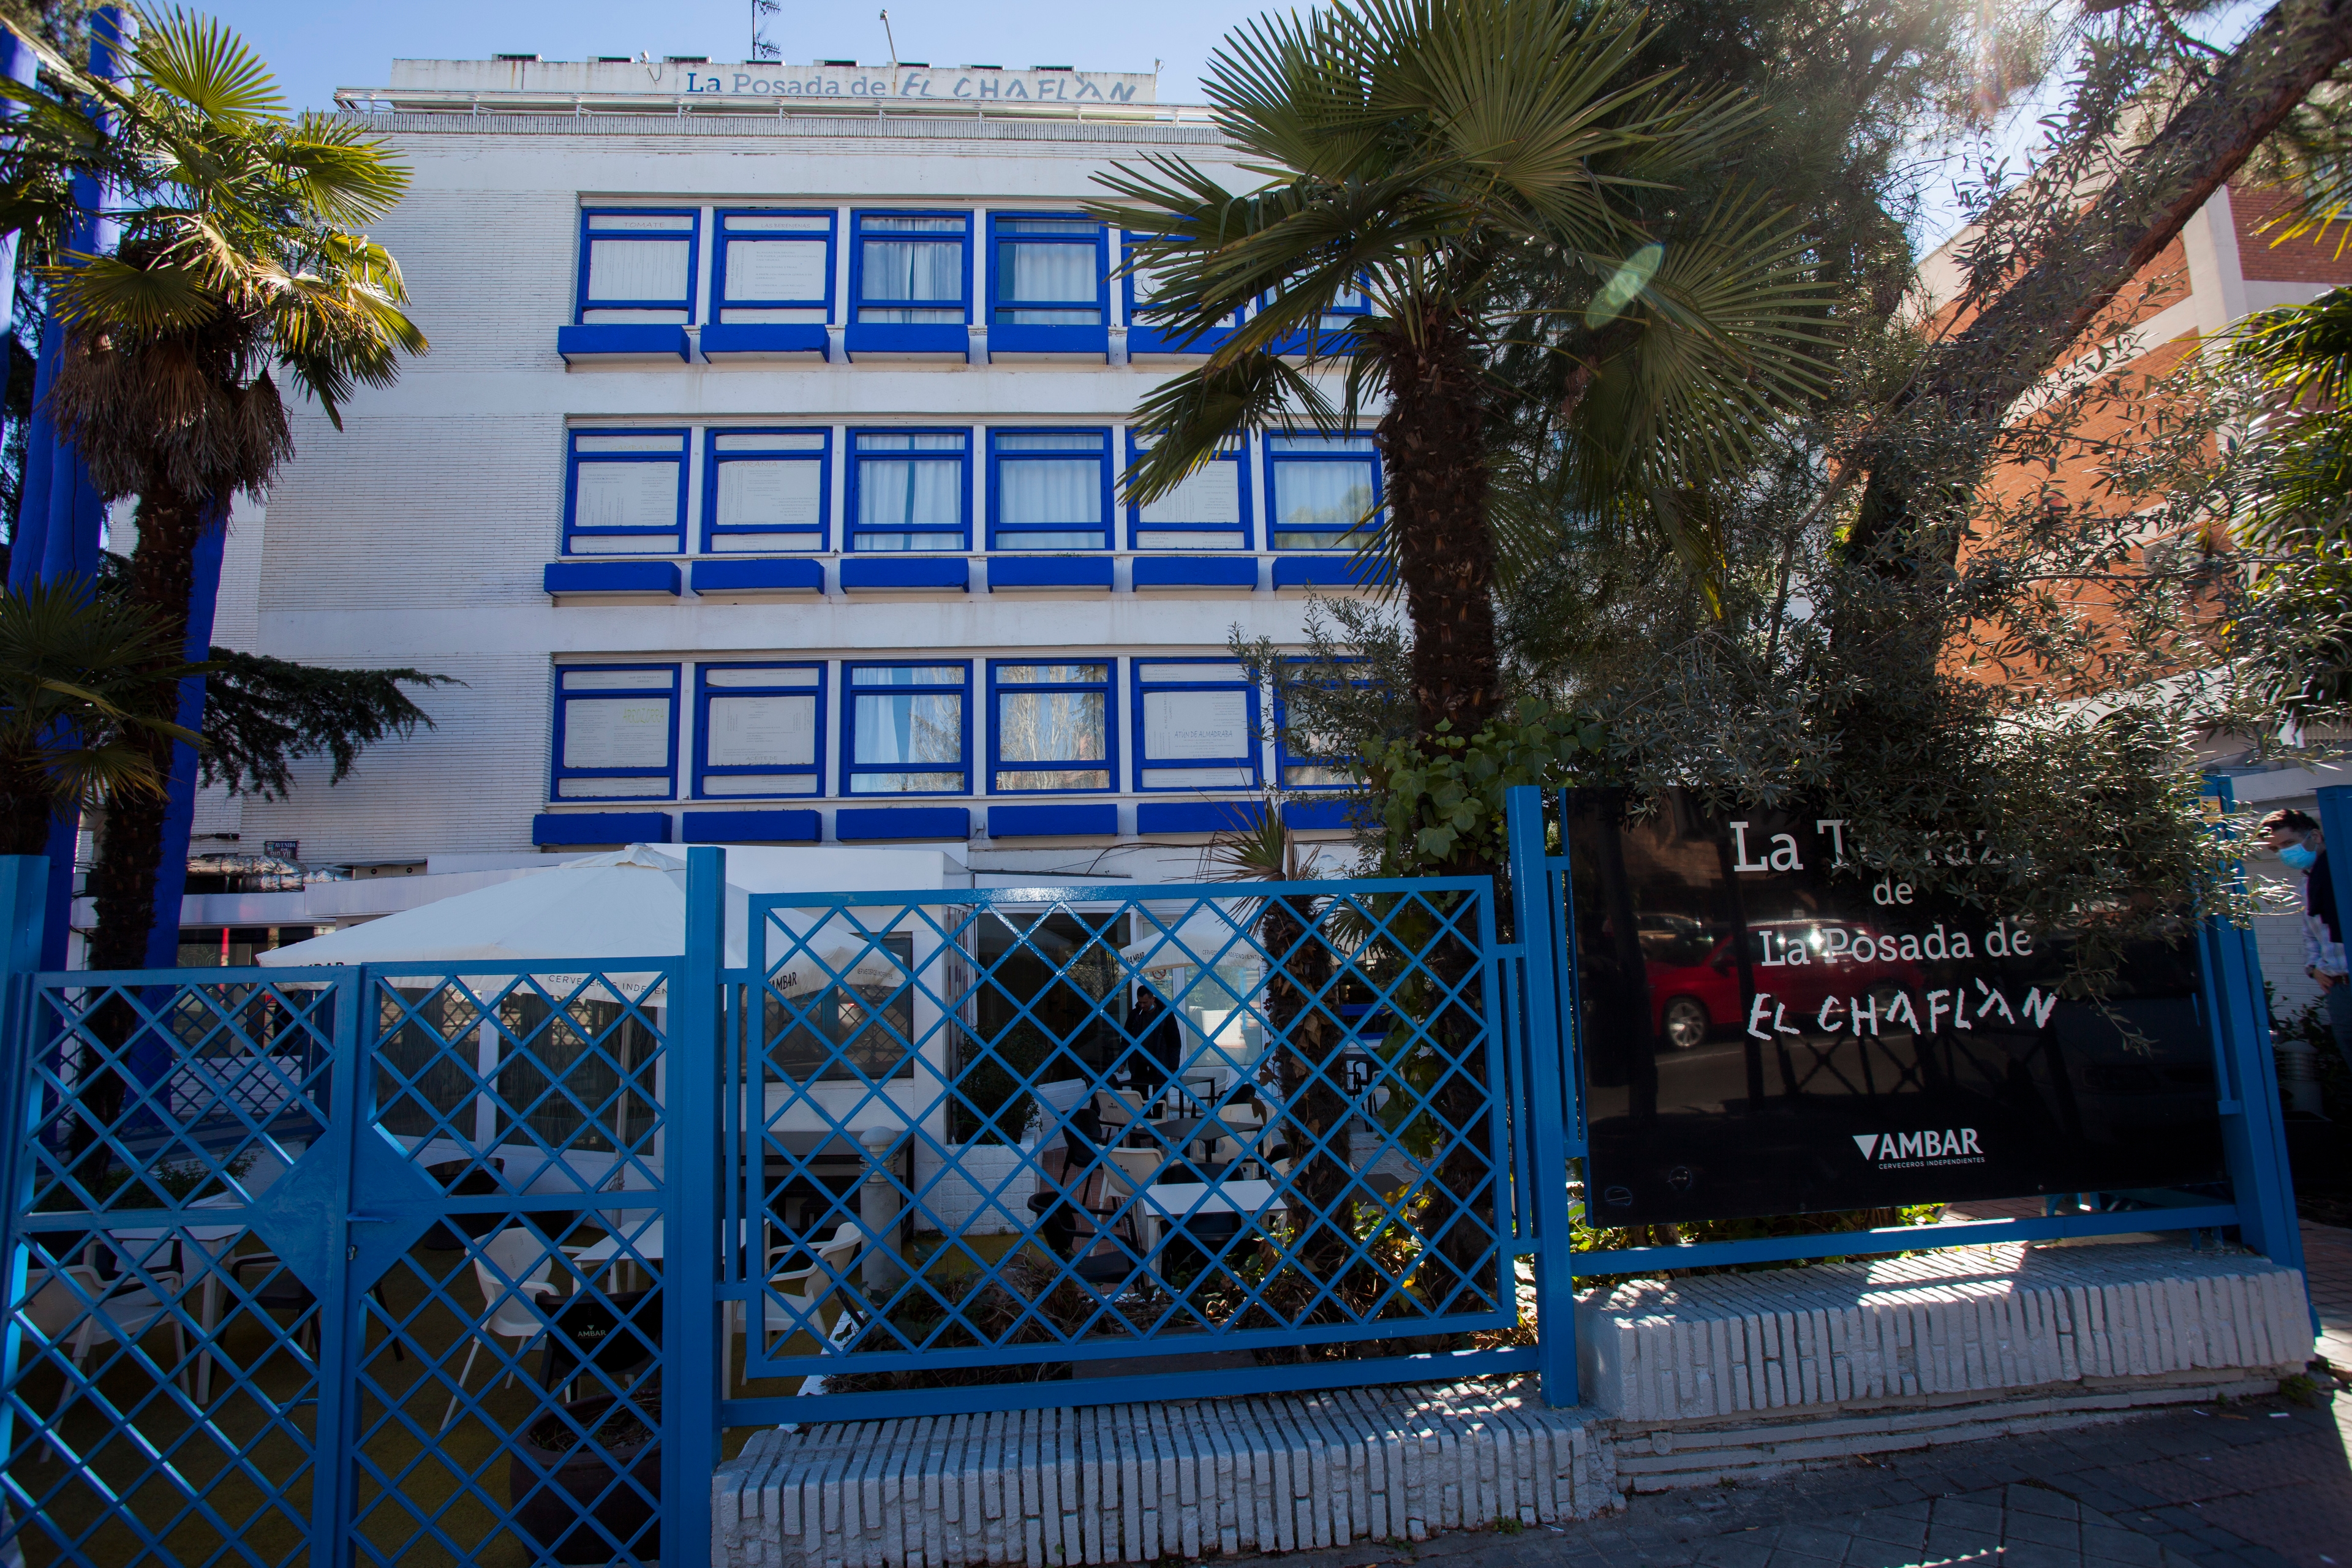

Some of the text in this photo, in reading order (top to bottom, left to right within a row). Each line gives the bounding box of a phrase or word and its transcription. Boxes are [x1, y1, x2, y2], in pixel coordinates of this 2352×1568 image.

[687, 73, 721, 93] La
[732, 73, 839, 94] Posada
[851, 76, 886, 96] de
[900, 73, 932, 97] EL
[623, 707, 664, 723] ARROZORRA
[1174, 729, 1189, 738] ATÚN
[1730, 821, 1803, 872] La
[1873, 877, 1913, 905] de
[1758, 922, 2034, 967] La Posada de
[1129, 952, 1145, 965] AMBAR
[1227, 952, 1262, 961] INDEPENDIENTES
[549, 975, 617, 989] CERVEERS
[772, 971, 797, 991] AMBAR
[1747, 993, 1801, 1041] EL
[1879, 1128, 1984, 1160] AMBAR
[1879, 1157, 1985, 1170] CERVECEROS INDEPENDIENTES
